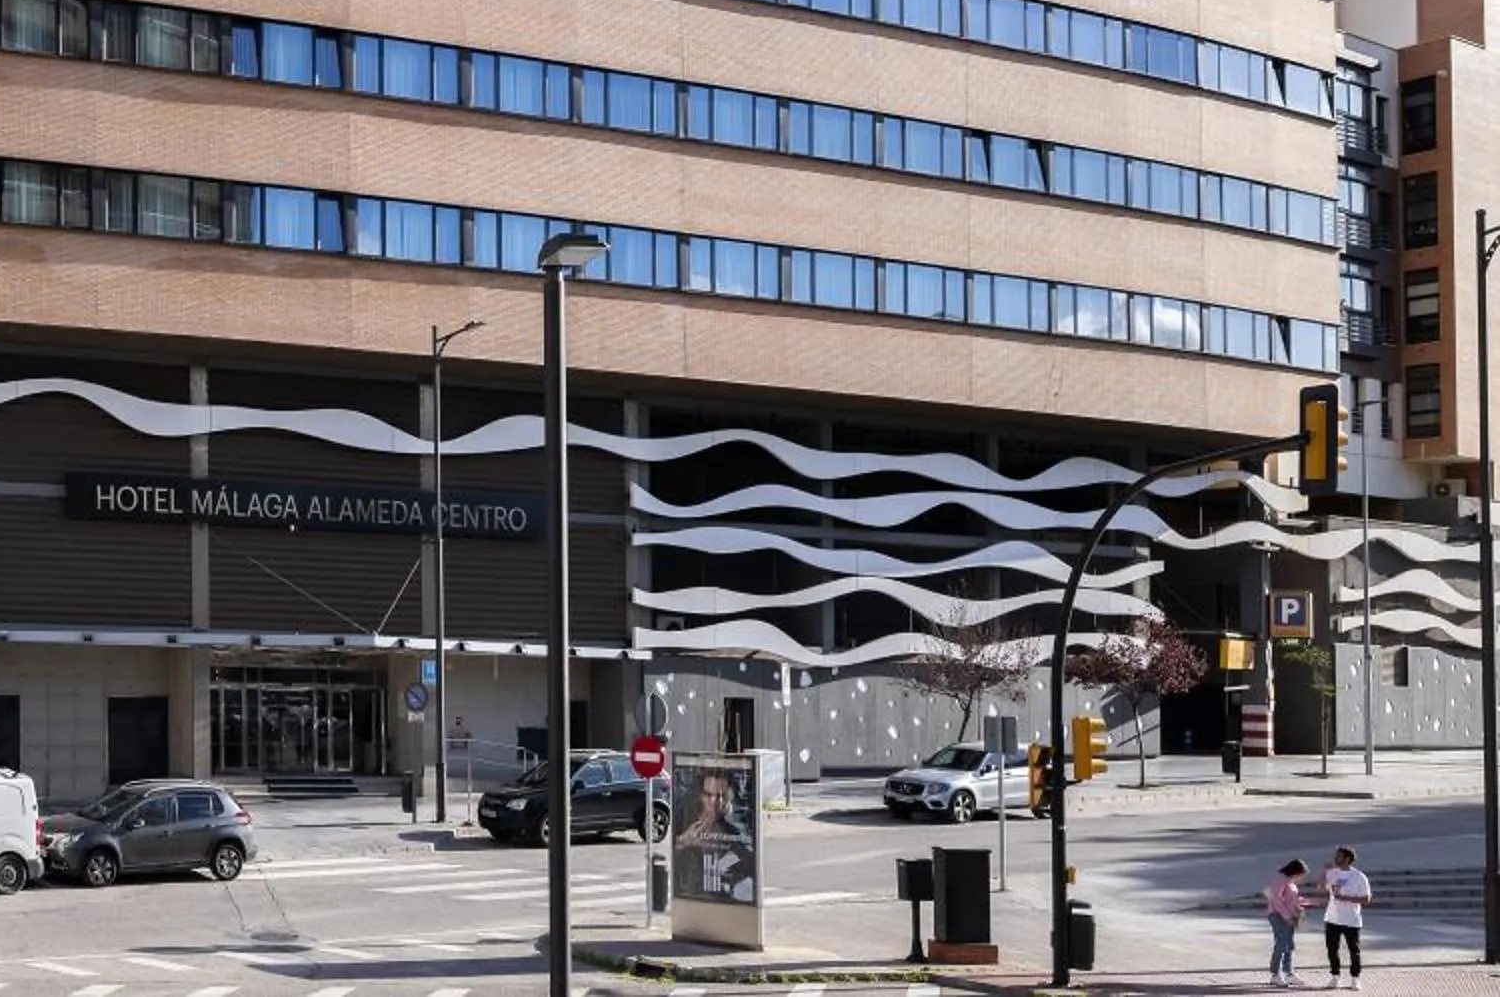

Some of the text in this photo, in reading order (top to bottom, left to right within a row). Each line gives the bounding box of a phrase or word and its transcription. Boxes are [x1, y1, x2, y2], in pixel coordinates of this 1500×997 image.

[96, 484, 527, 532] HOTEL MÁLAGA ALAMEDA CENTRO
[1281, 598, 1300, 624] P
